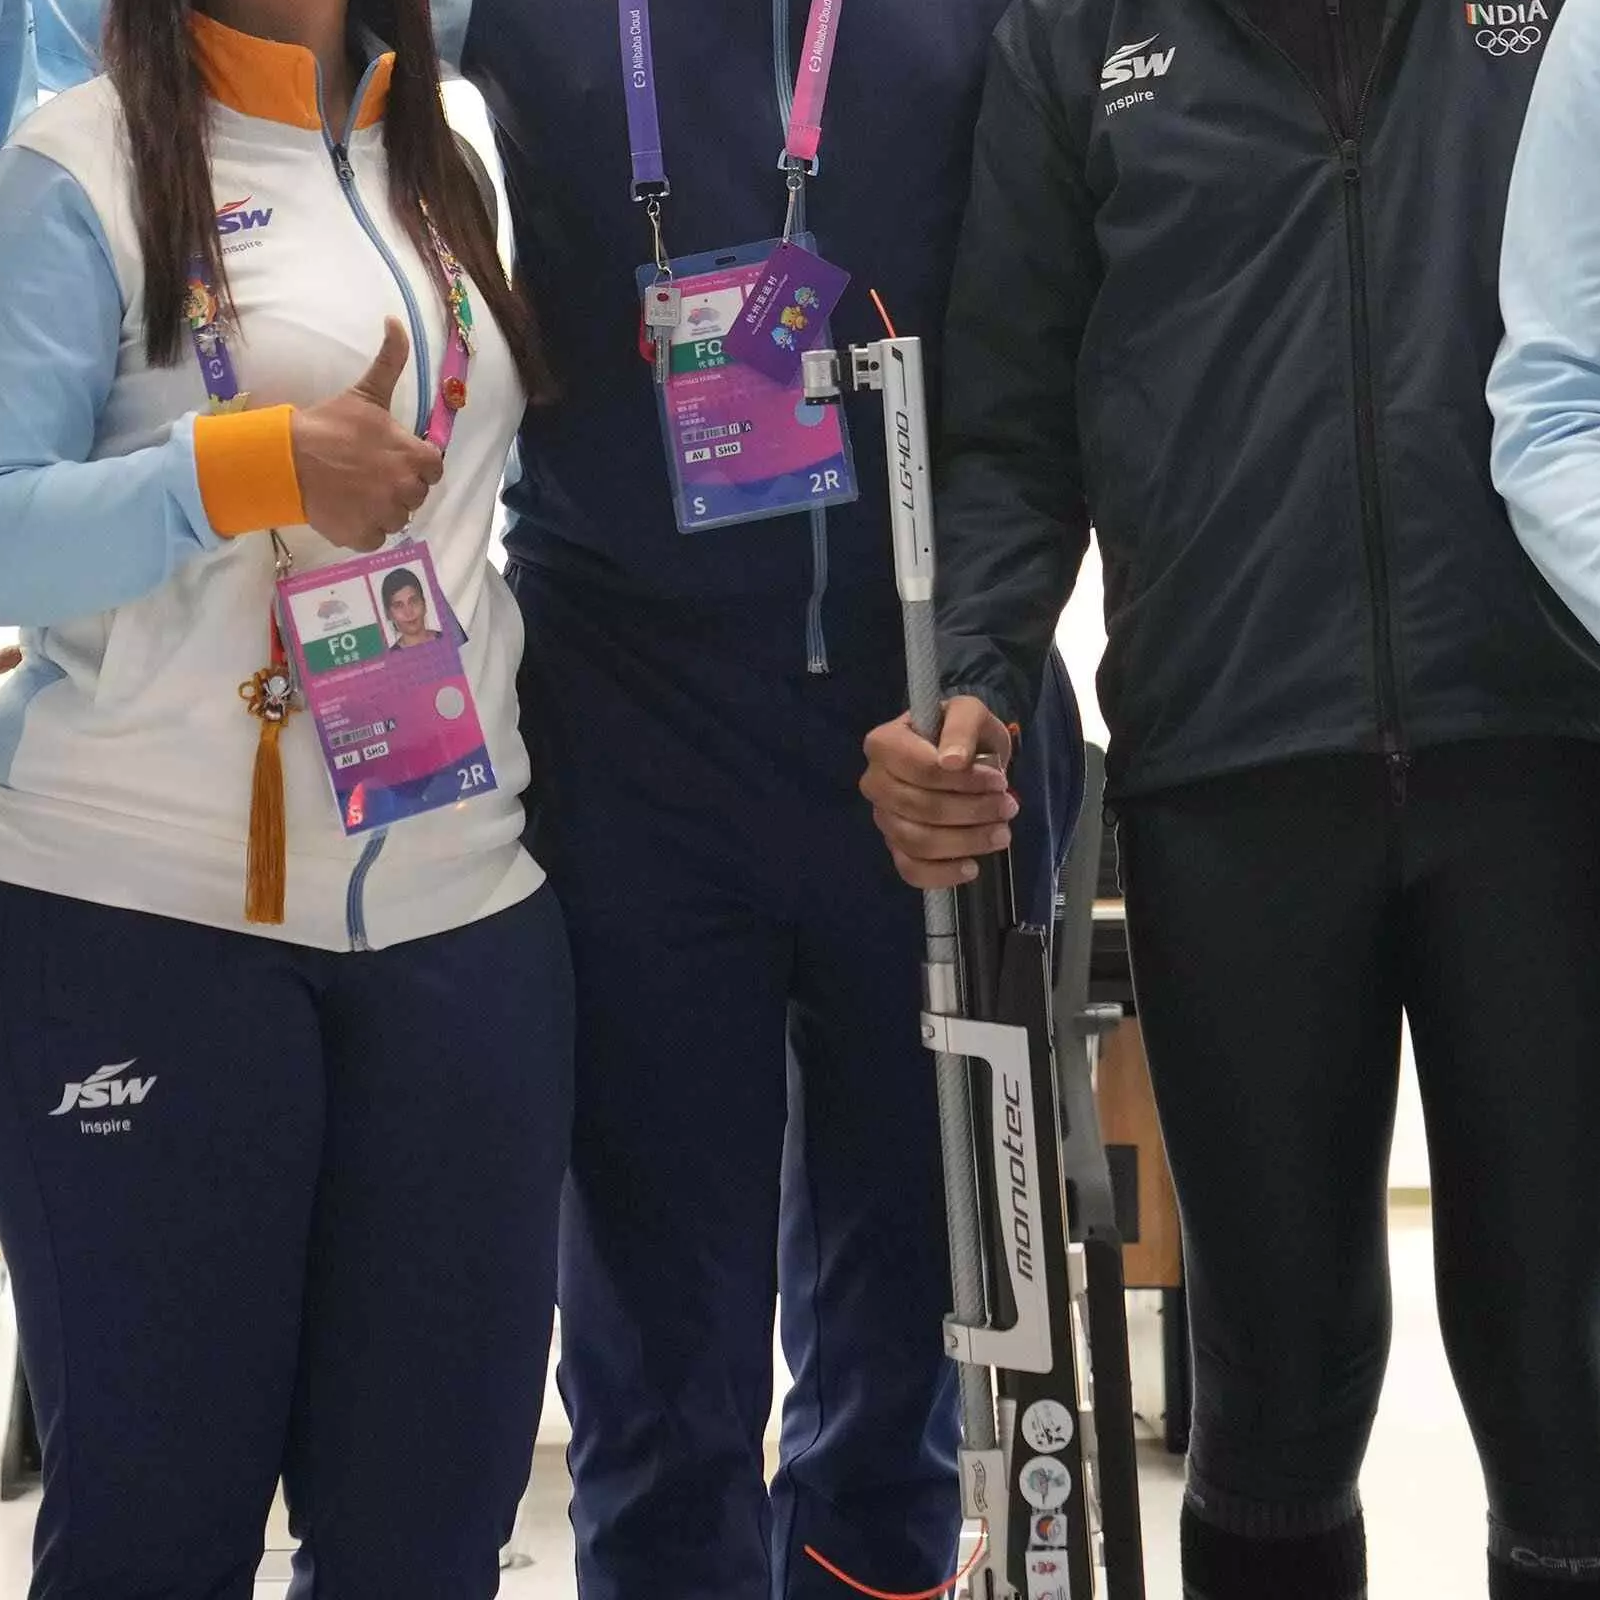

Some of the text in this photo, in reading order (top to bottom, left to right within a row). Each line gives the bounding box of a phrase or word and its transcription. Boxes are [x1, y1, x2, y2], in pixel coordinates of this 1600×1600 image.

[629, 9, 641, 36] Cloud
[1465, 0, 1549, 28] INDIA
[1101, 33, 1176, 90] SW
[1105, 89, 1155, 116] Inspire
[215, 197, 273, 236] SW
[694, 340, 723, 359] FO
[692, 443, 738, 461] AV SHO
[895, 411, 915, 511] LG400
[809, 469, 841, 494] 2R
[693, 496, 706, 515] S
[327, 633, 357, 656] FO
[341, 755, 353, 765] AV
[457, 764, 489, 790] 2R
[349, 804, 364, 825] S
[48, 1057, 158, 1116] JSW
[80, 1119, 132, 1136] Inspire
[1002, 1070, 1034, 1283] monotec
